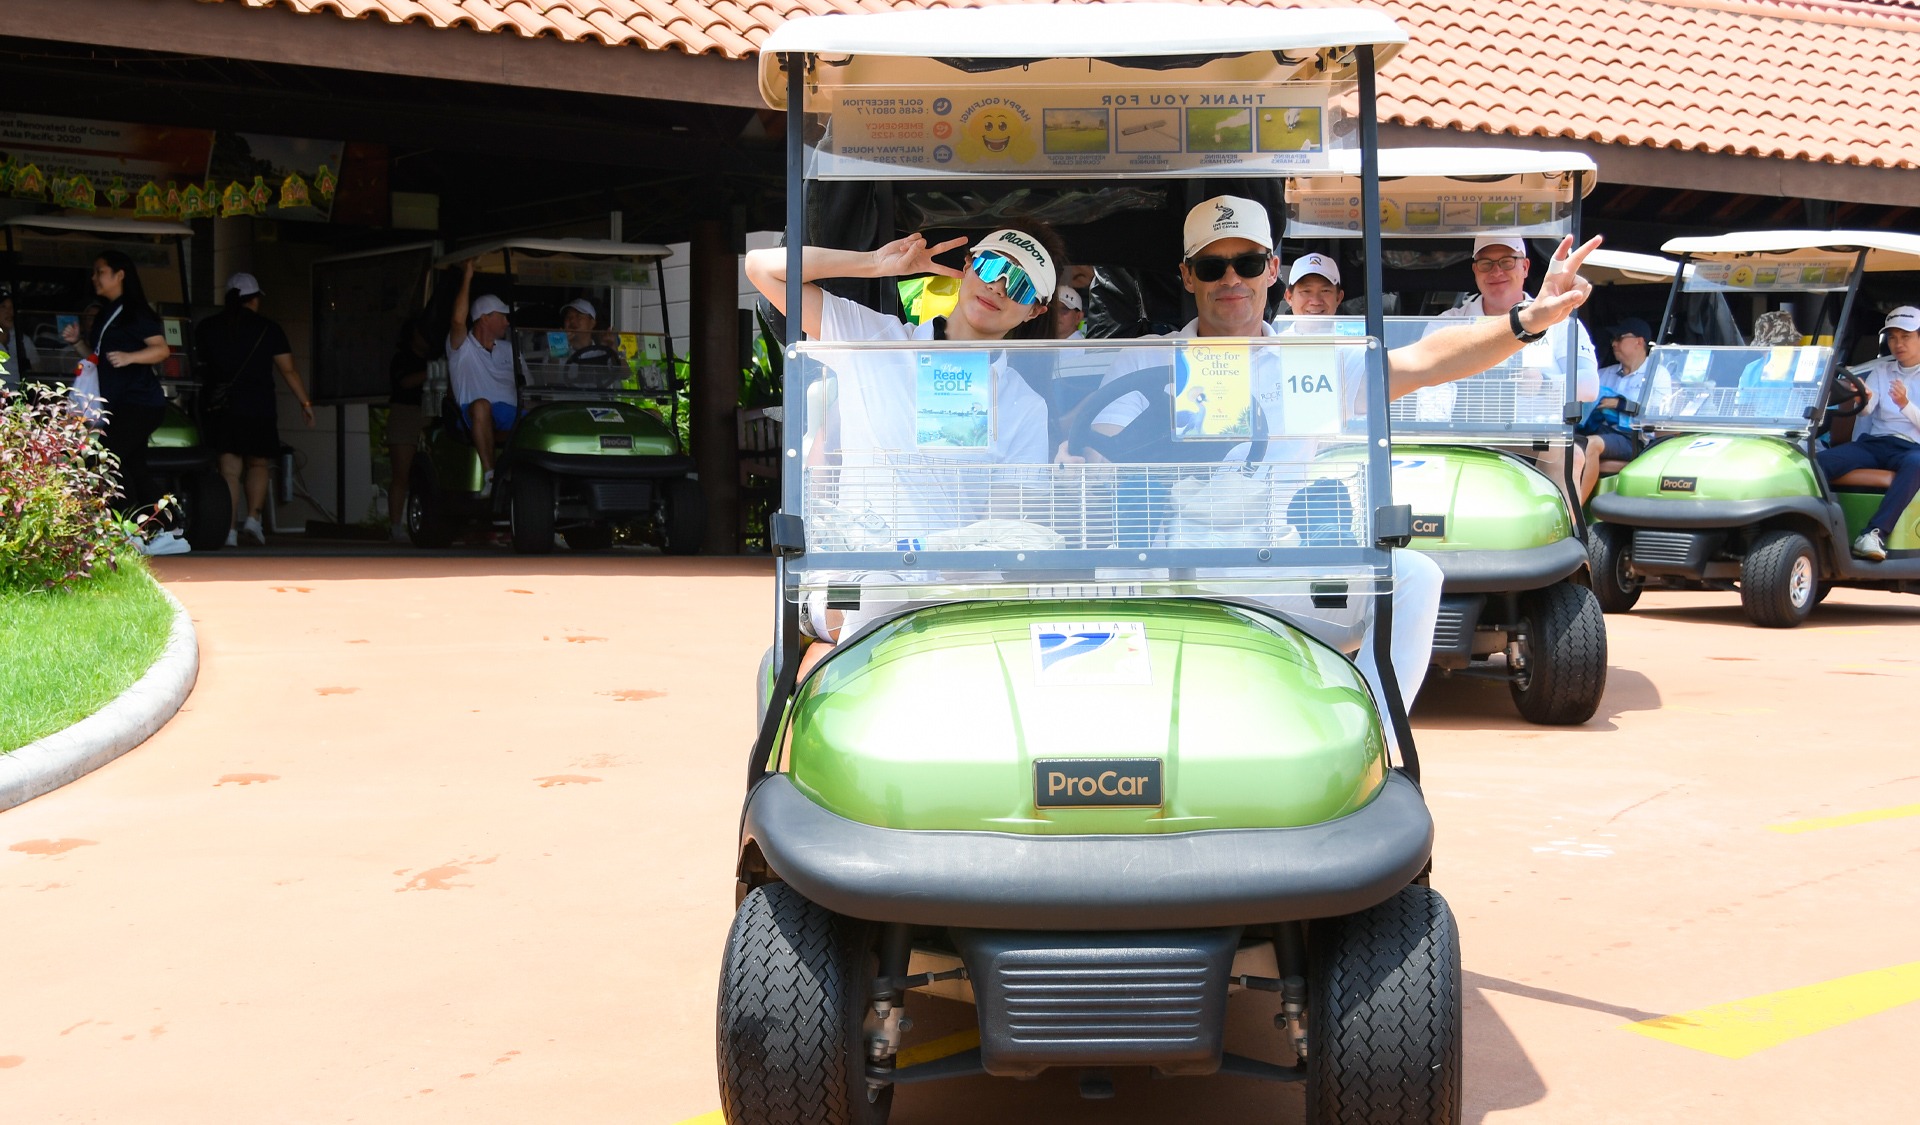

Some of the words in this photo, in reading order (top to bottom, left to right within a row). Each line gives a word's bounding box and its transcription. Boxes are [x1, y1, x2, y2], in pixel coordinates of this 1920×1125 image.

[0, 120, 13, 128] est
[16, 120, 66, 132] Renovated
[68, 124, 88, 134] Golf
[89, 127, 120, 137] Course
[3, 129, 22, 138] Asia
[24, 131, 55, 142] Pacific
[57, 134, 82, 144] 2020
[999, 232, 1045, 267] Malbon
[1195, 351, 1221, 361] Care
[1224, 352, 1240, 361] for
[1212, 360, 1229, 369] the
[933, 369, 972, 383] Ready
[1201, 368, 1240, 376] Course
[933, 380, 972, 391] GOLF
[1287, 374, 1333, 393] 16A
[603, 438, 629, 446] ProCar
[1663, 479, 1693, 489] ProCar
[1412, 519, 1438, 533] Car
[1048, 770, 1149, 797] ProCar
